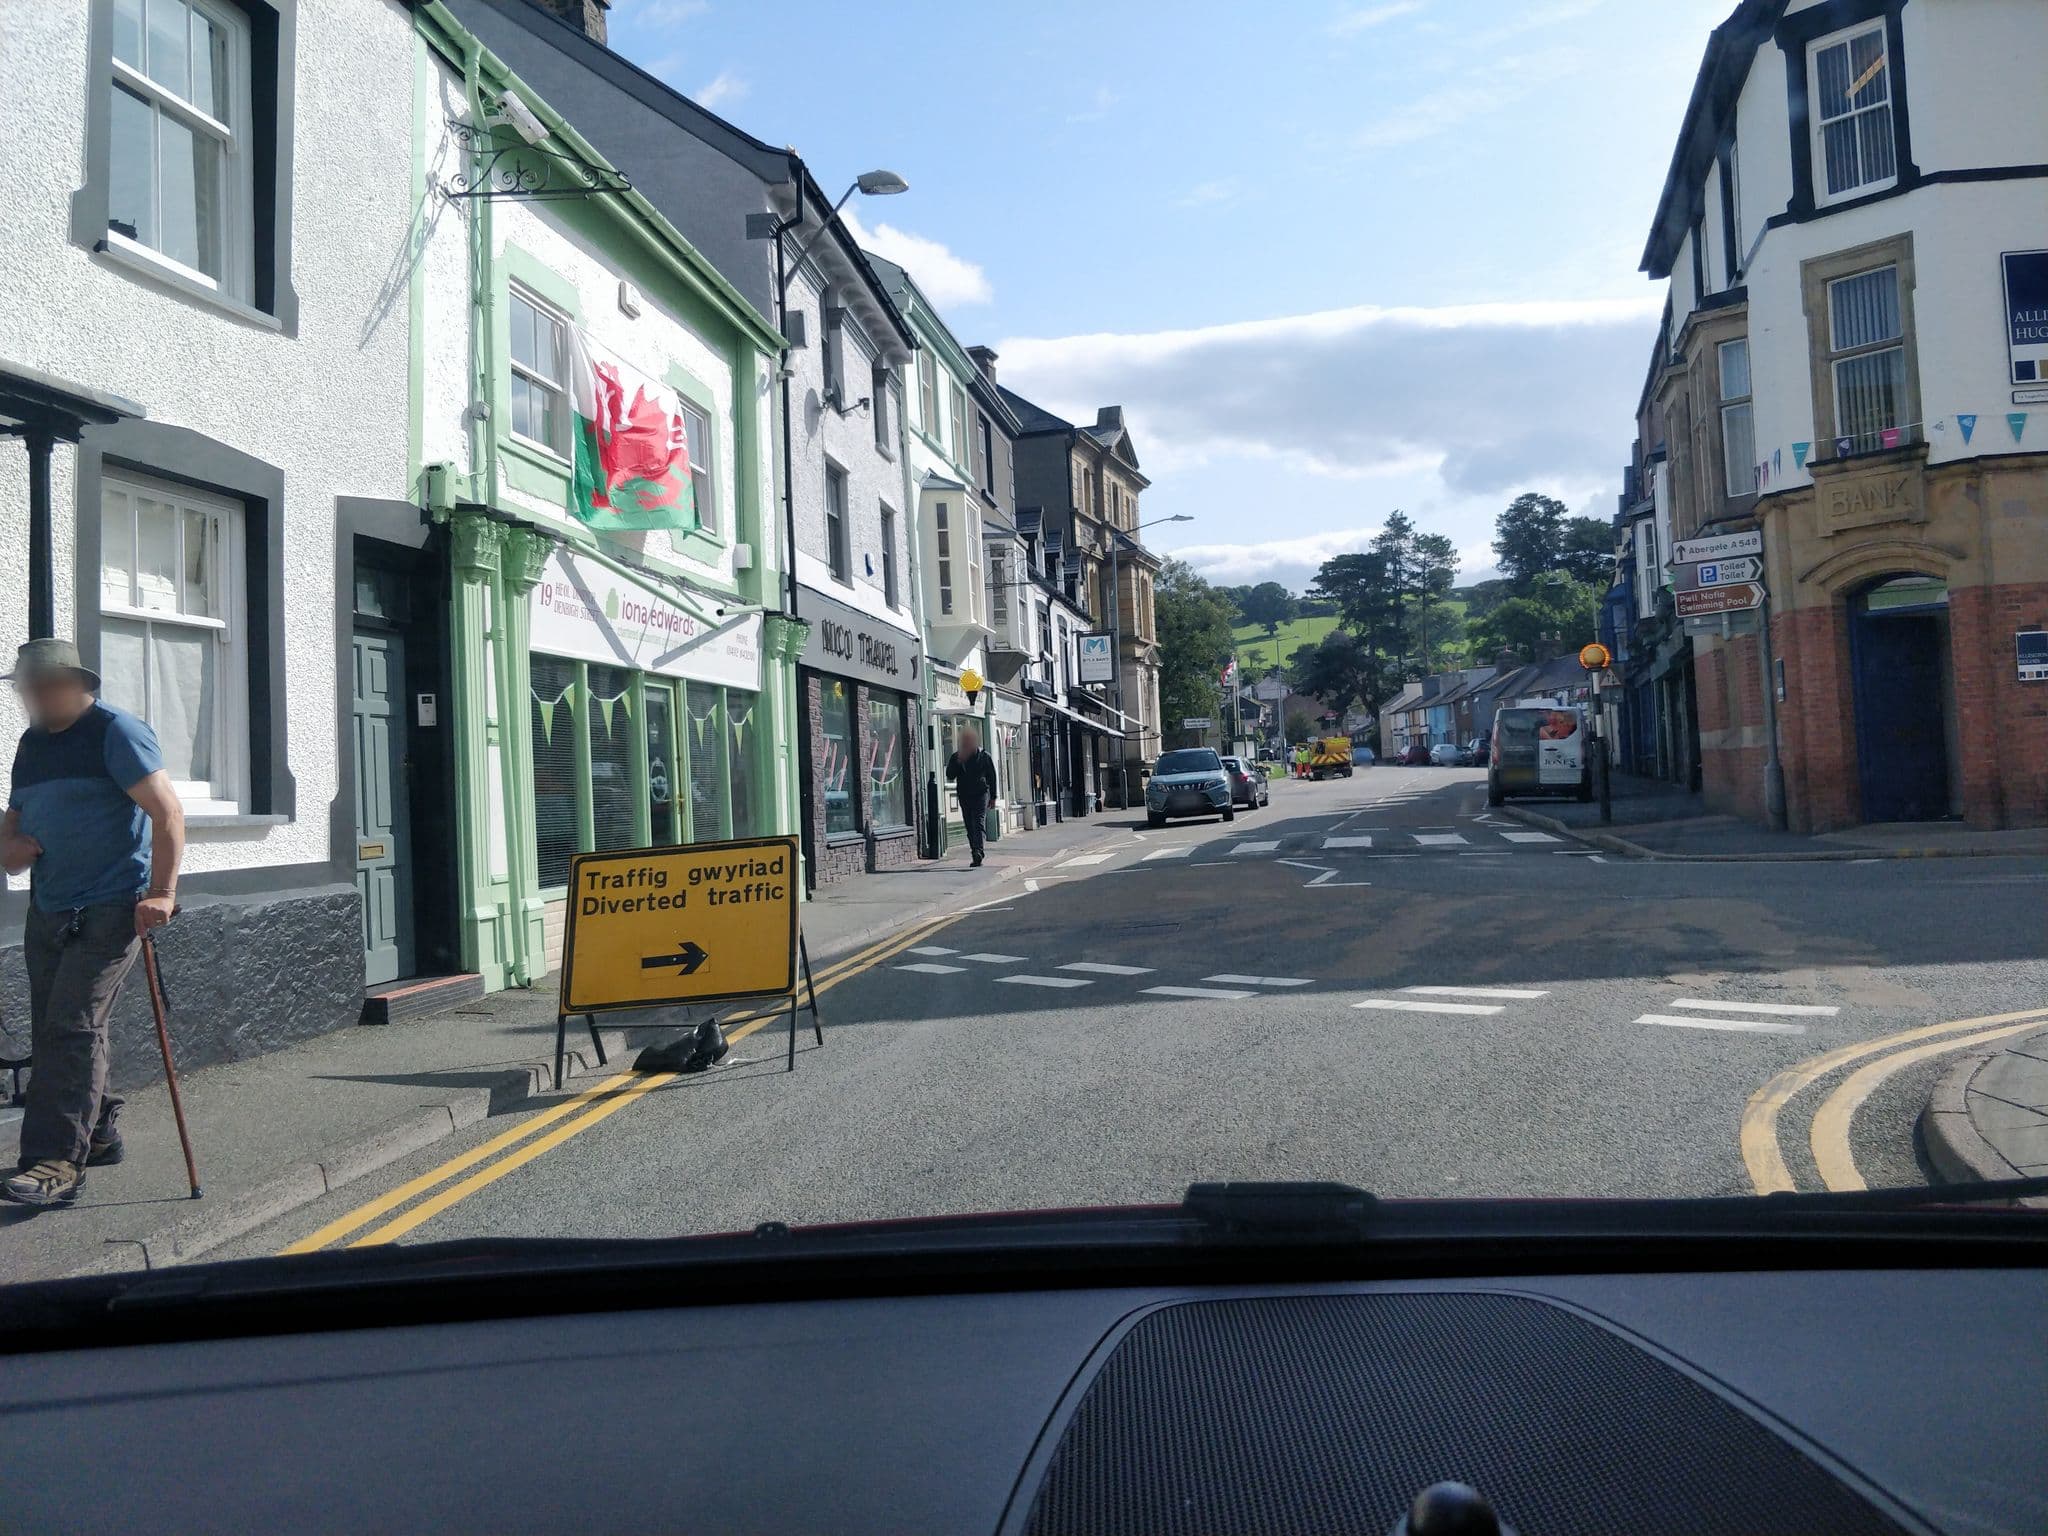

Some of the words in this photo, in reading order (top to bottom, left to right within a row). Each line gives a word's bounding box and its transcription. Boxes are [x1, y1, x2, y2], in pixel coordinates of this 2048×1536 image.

[1831, 477, 1908, 518] BANK
[1688, 542, 1728, 554] Abergele
[1702, 567, 1714, 582] P
[1720, 561, 1746, 572] Toiled
[1720, 571, 1745, 581] Toilet
[540, 583, 553, 606] 19
[1679, 593, 1698, 603] Pwll
[1680, 601, 1724, 612] Swimming
[1727, 596, 1748, 606] Pool
[622, 593, 647, 625] iona
[650, 604, 695, 637] edwards
[822, 618, 853, 661] NICO
[857, 632, 899, 676] TRAVEL
[1544, 757, 1576, 766] JONES
[586, 868, 668, 890] Traffig
[688, 856, 784, 886] gwyriad
[582, 889, 687, 916] Diverted
[707, 884, 785, 906] traffic
